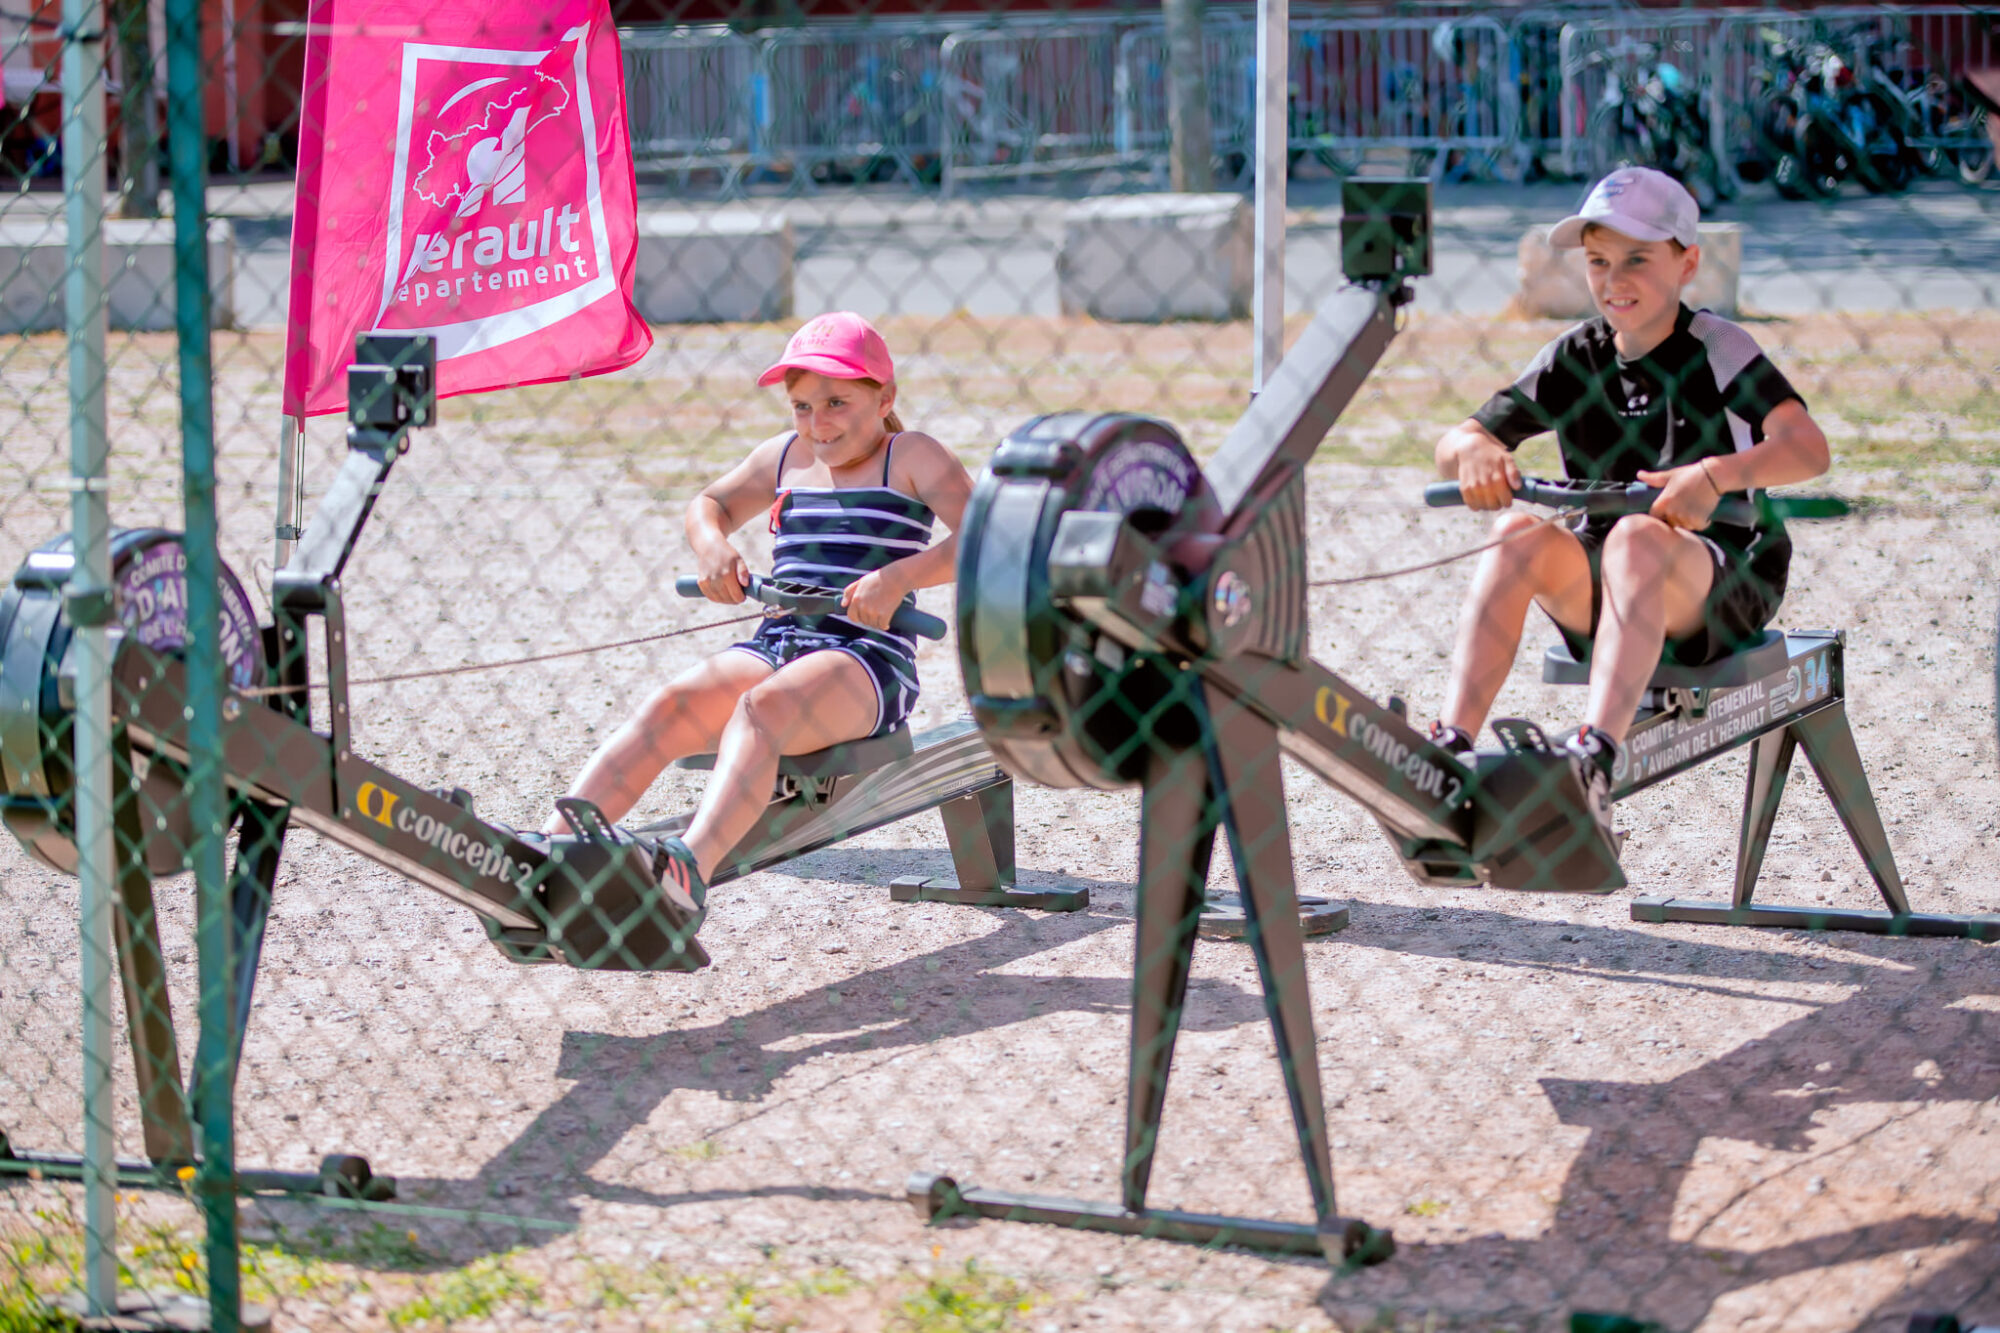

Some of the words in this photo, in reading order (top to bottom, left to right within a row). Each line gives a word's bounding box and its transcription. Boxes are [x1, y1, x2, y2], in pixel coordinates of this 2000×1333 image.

[398, 255, 588, 307] epartement
[1804, 650, 1829, 701] 34
[1692, 732, 1708, 756] DE
